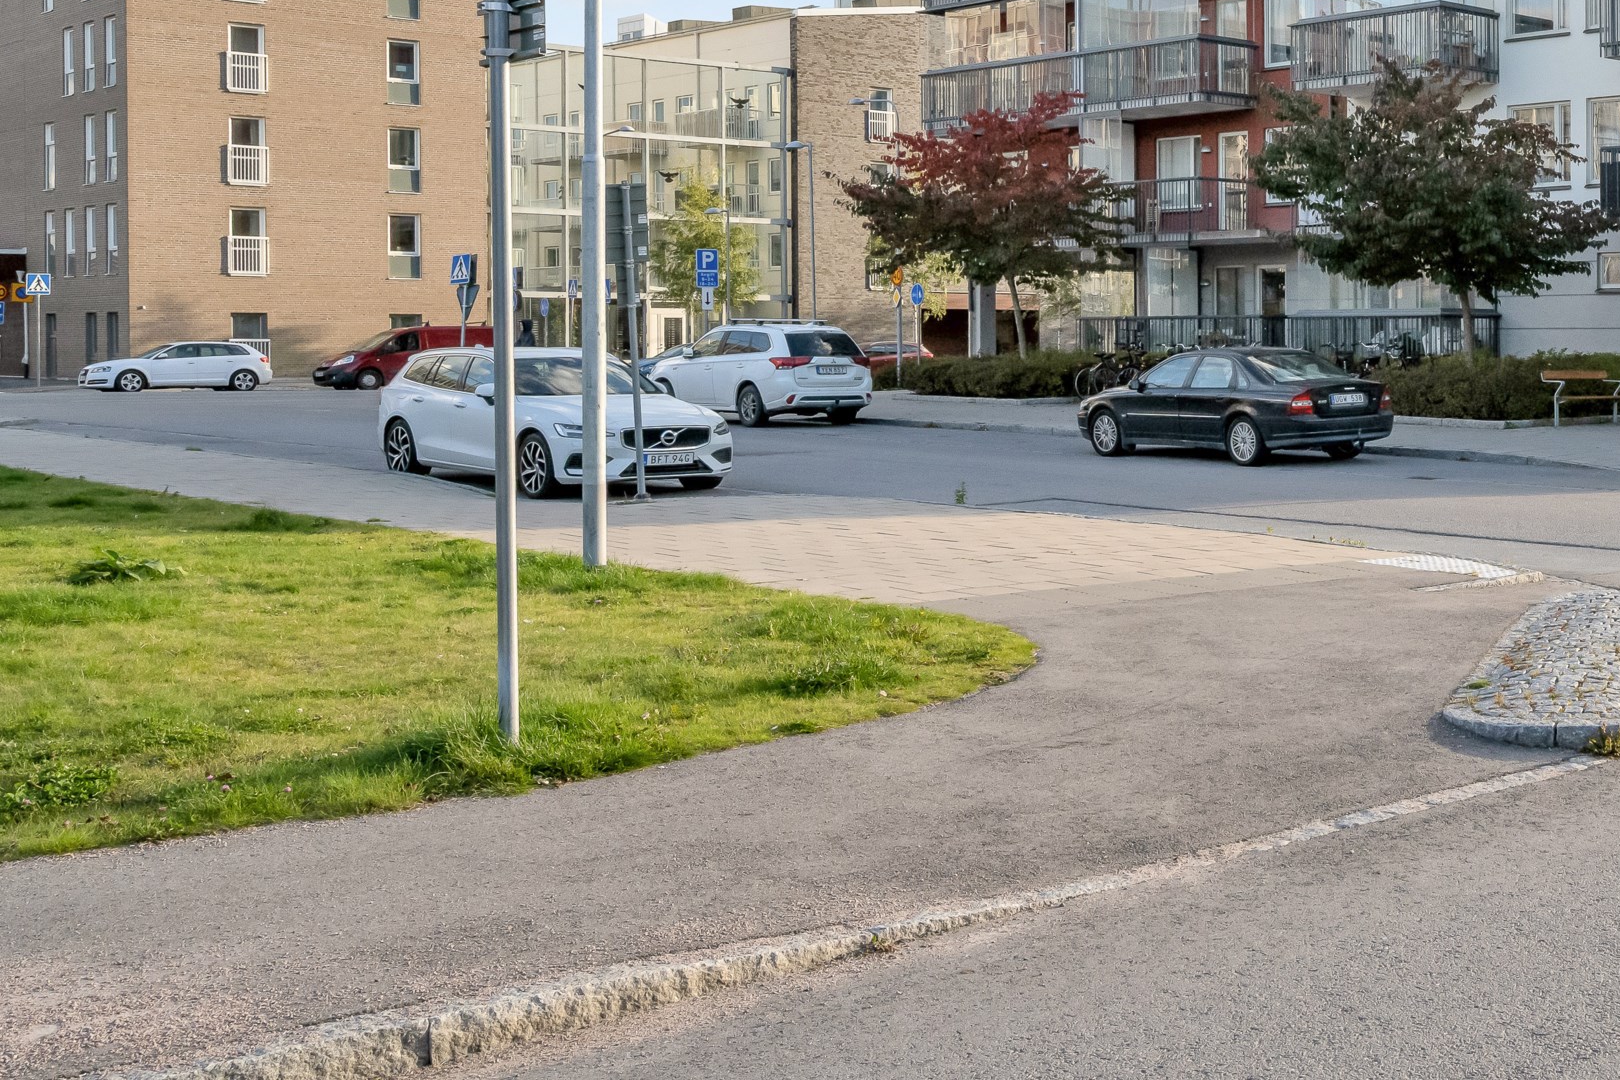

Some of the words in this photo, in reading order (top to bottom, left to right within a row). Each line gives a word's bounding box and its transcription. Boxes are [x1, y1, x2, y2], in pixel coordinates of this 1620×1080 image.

[702, 251, 714, 269] P
[650, 455, 669, 464] BFT
[672, 453, 690, 464] 94G
